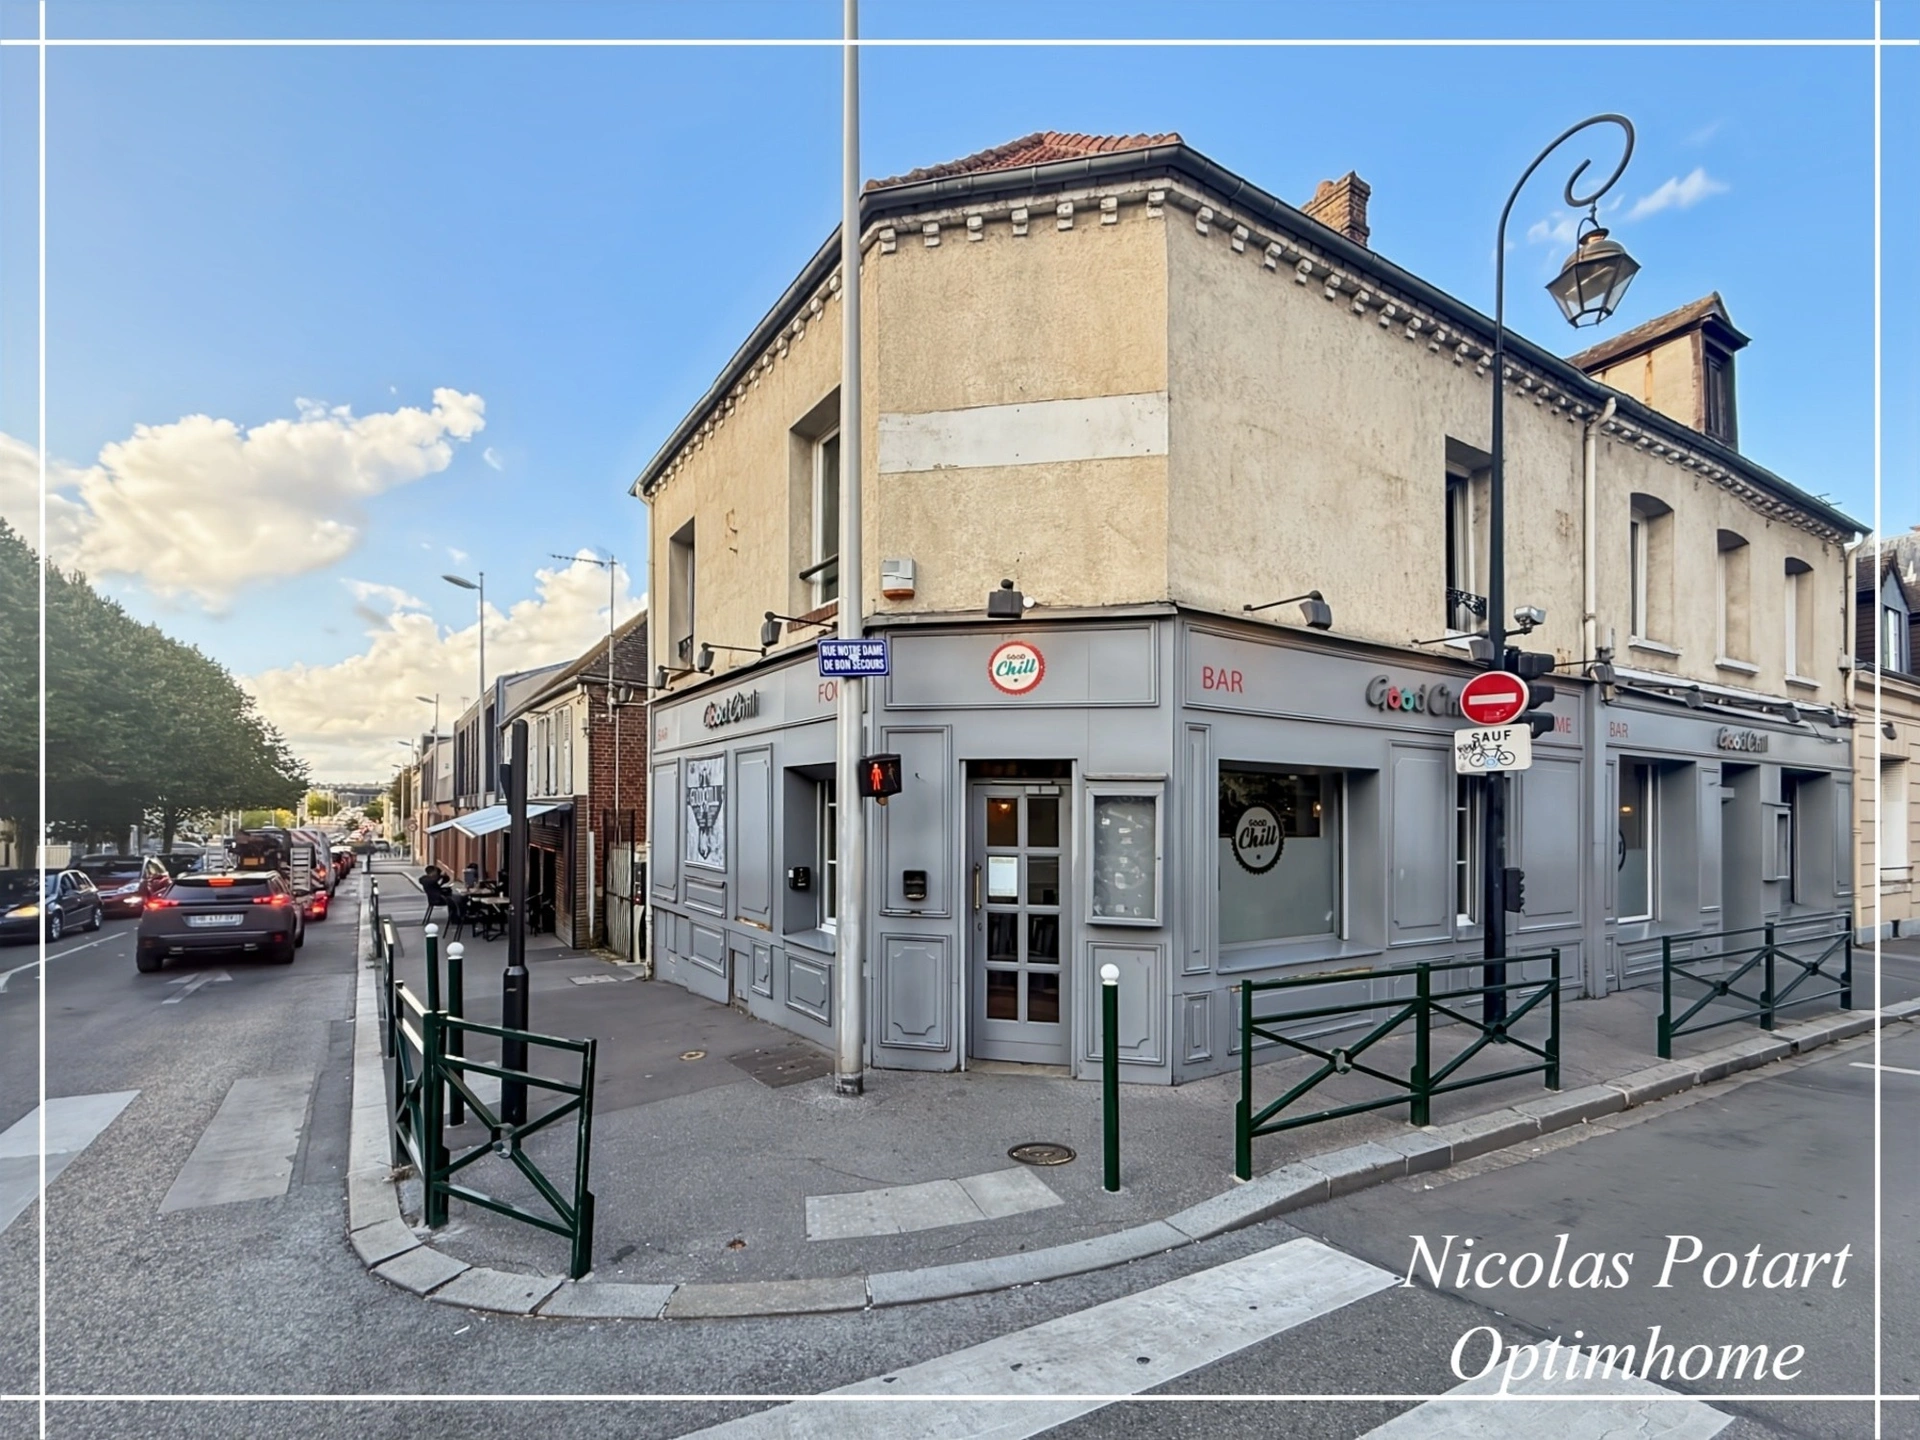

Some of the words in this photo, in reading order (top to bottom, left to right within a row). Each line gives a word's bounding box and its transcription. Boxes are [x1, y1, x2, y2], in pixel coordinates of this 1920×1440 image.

[822, 645, 836, 656] RUE
[863, 644, 883, 656] DAME
[824, 660, 833, 670] DE
[835, 659, 851, 670] BON
[852, 659, 884, 670] SECOURS
[995, 658, 1037, 677] Chill
[1202, 666, 1243, 693] BAR
[1365, 674, 1426, 713] Good
[1471, 729, 1512, 742] SAUF
[1609, 721, 1629, 738] BAR
[1238, 824, 1278, 849] Chill
